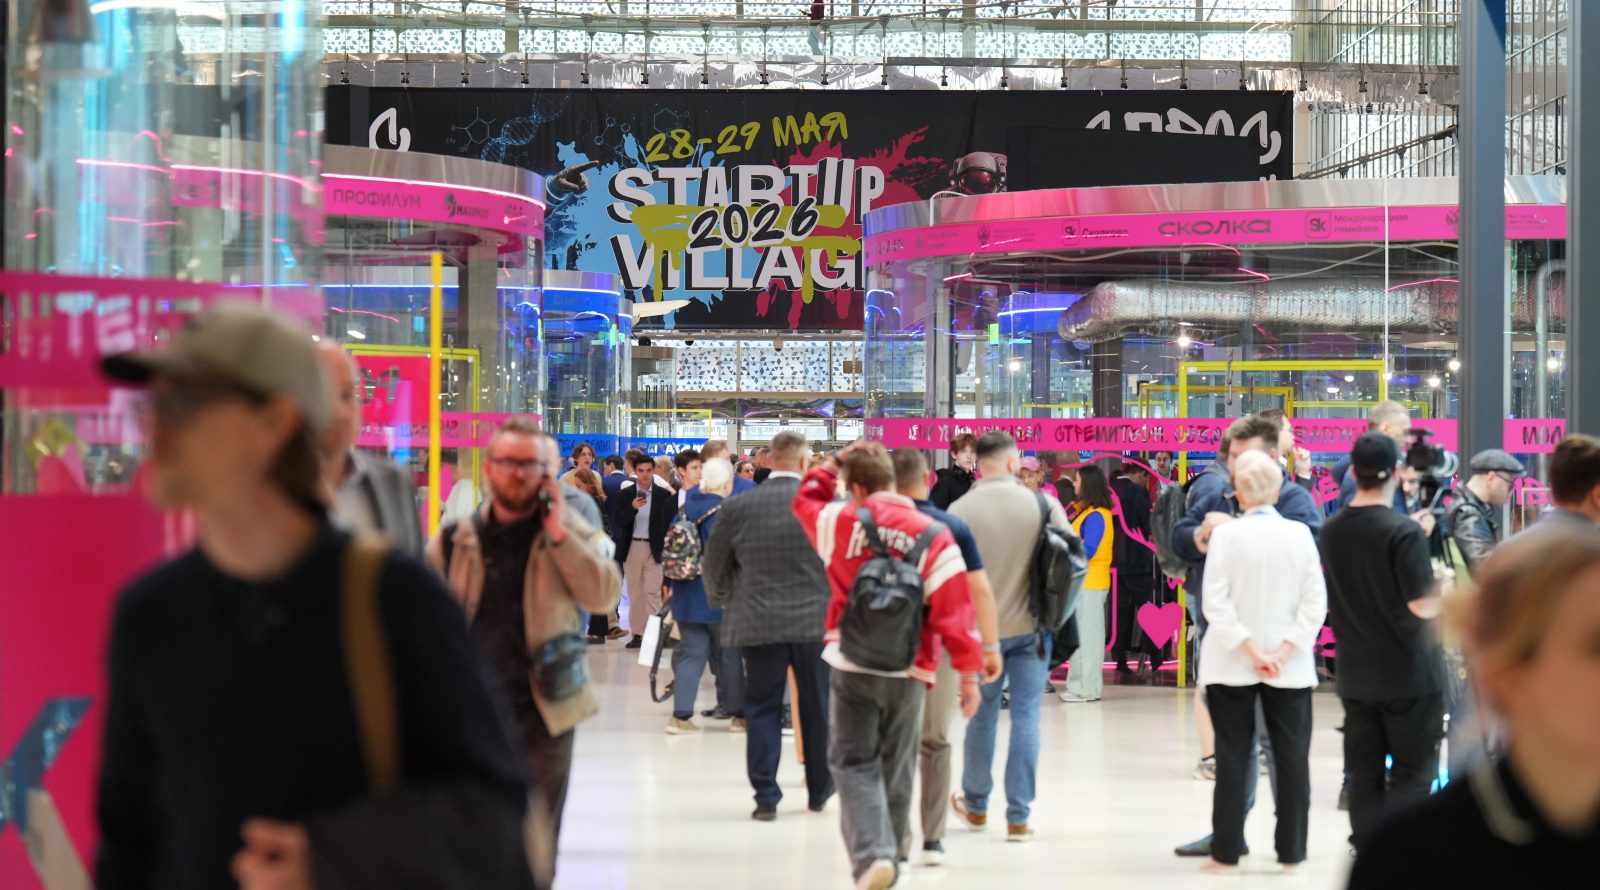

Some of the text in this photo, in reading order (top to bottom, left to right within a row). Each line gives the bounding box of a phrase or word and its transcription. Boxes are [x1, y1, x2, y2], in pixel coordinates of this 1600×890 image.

[645, 111, 848, 163] 28-29 МАЯ
[606, 156, 886, 225] STARTUP
[687, 196, 820, 253] 2026
[609, 233, 867, 292] VILLAG
[1522, 425, 1567, 445] МОЛ
